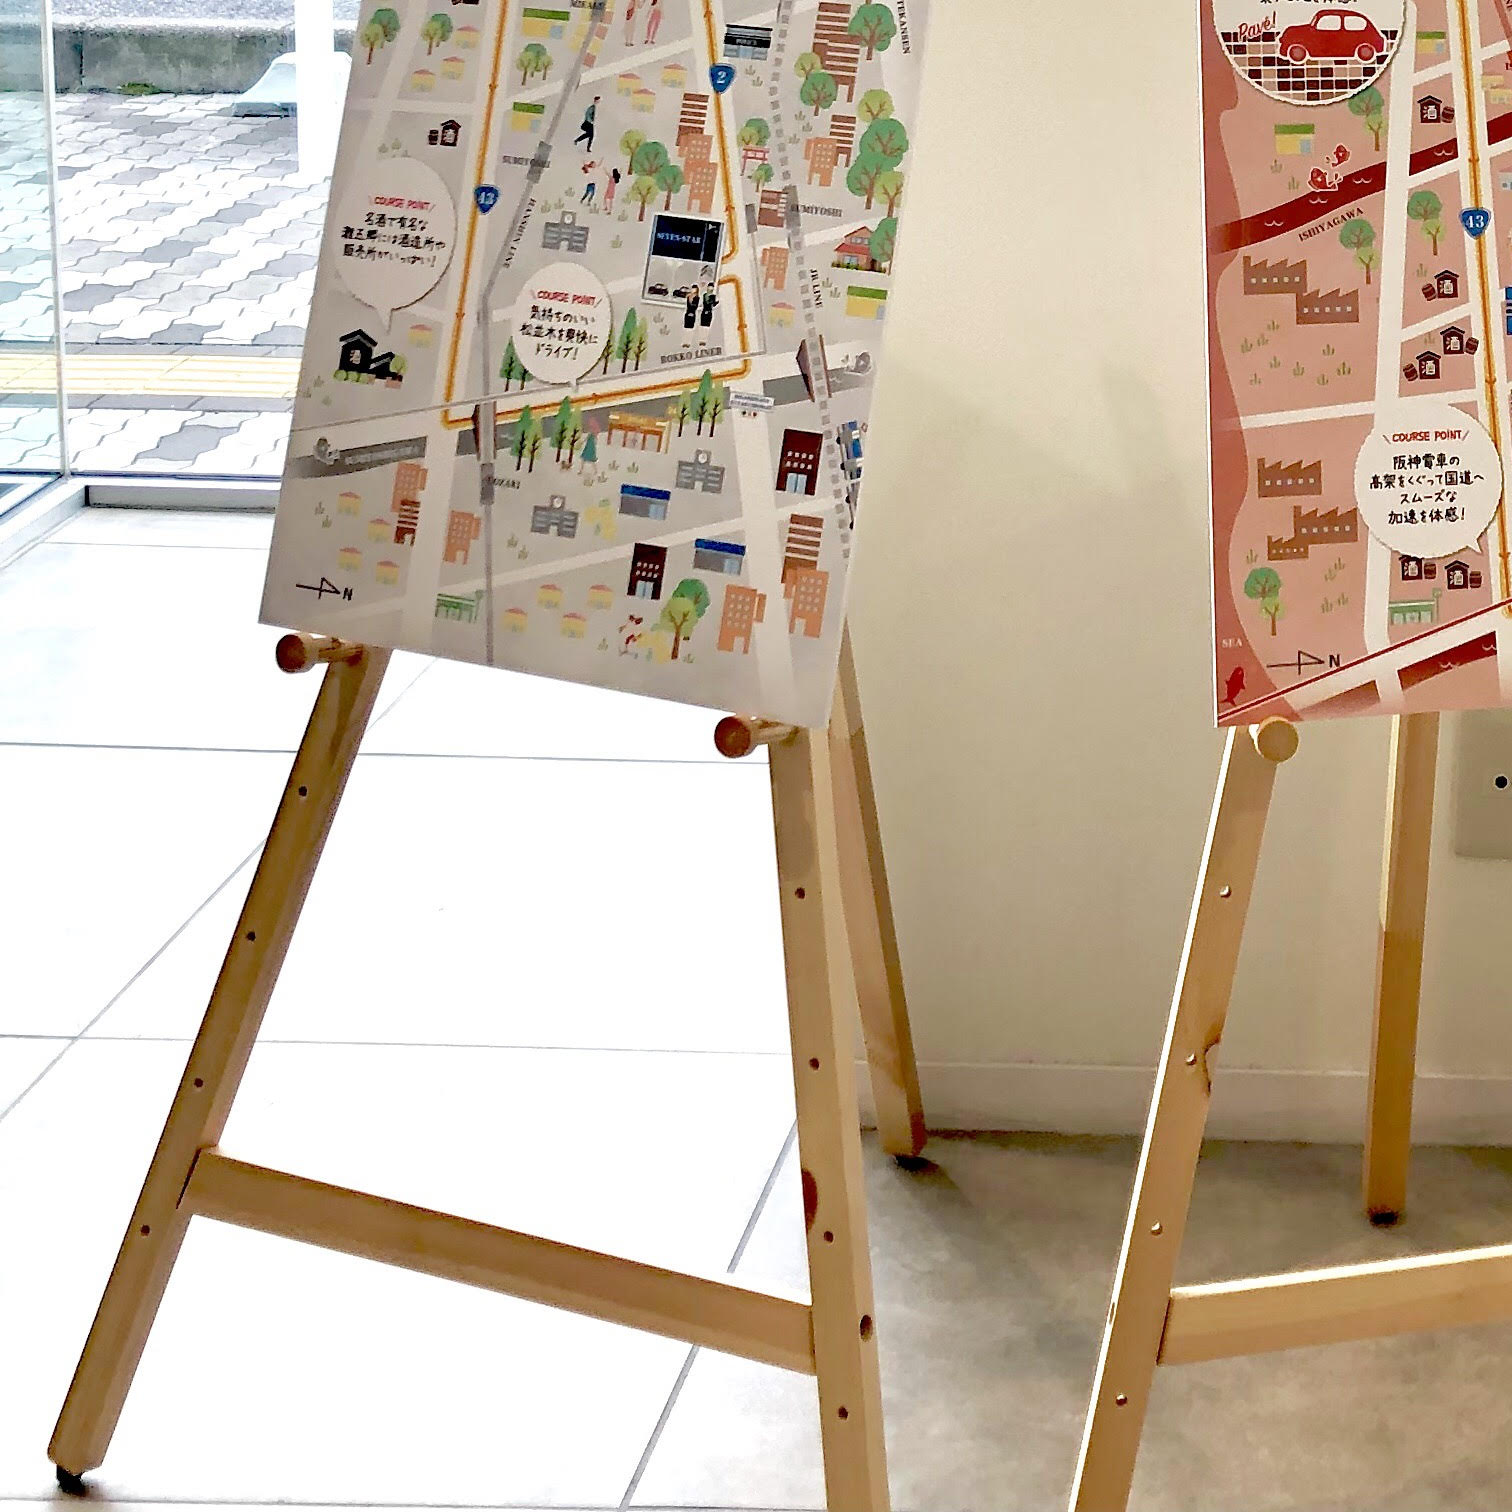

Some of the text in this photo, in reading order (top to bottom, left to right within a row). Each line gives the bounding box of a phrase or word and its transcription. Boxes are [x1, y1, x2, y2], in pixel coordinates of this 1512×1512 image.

[717, 71, 727, 83] 2
[373, 196, 431, 210] COURSE POINT
[1298, 206, 1364, 242] ISHIYAGAWA
[1464, 214, 1486, 230] 43
[537, 289, 597, 306] COURSE POINT
[1391, 428, 1464, 443] COURSE POINT
[1393, 454, 1461, 470] 阪神電車の
[1368, 469, 1485, 489] 高架をくぐって国道へ
[1399, 489, 1457, 505] スムーズな
[1221, 637, 1243, 648] SEA
[1328, 654, 1341, 668] N
